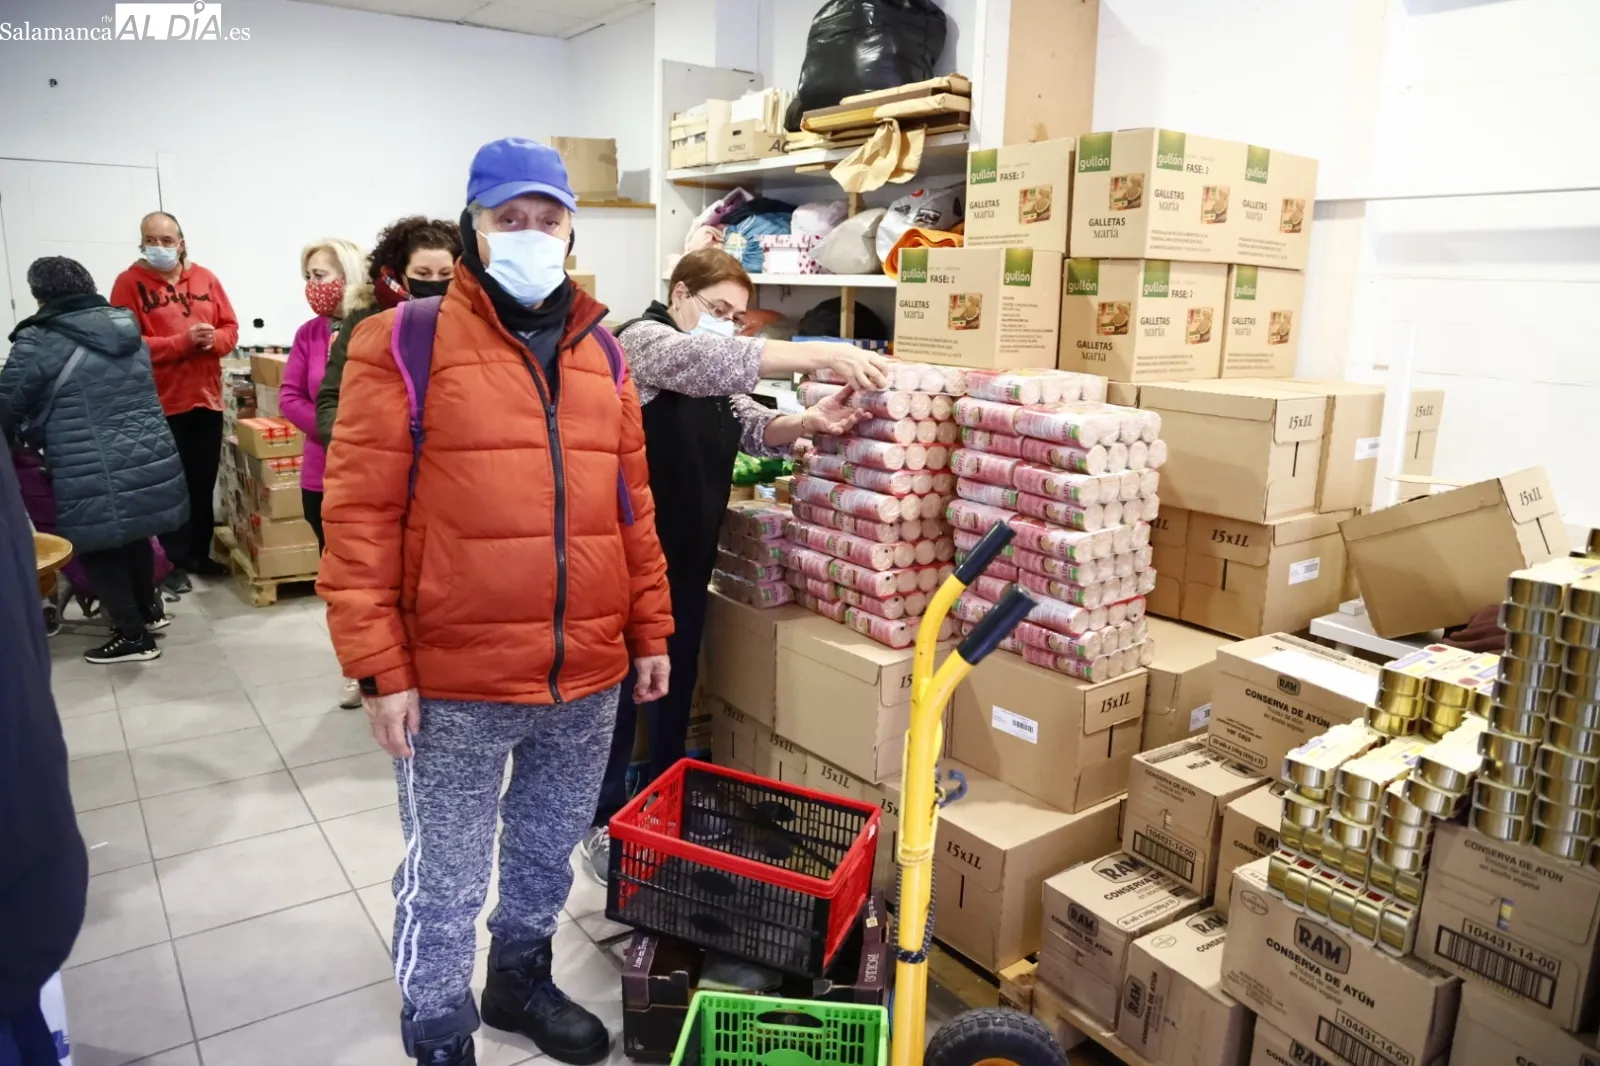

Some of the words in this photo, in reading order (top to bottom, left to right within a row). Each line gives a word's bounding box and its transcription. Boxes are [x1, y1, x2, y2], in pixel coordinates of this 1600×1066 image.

[1080, 154, 1110, 171] gullón
[1158, 152, 1183, 166] gullón
[971, 168, 996, 183] gullón
[1154, 188, 1185, 200] GALLETAS
[969, 199, 1000, 209] GALLETAS
[1088, 217, 1126, 227] GALLETAS
[902, 268, 927, 281] gullón
[930, 274, 950, 284] FASE:
[1005, 270, 1031, 283] gullón
[1068, 278, 1097, 293] gullón
[1143, 280, 1168, 295] gullón
[899, 299, 930, 309] GALLETAS
[1140, 317, 1171, 326] GALLETAS
[1076, 340, 1113, 351] GALLETAS
[1287, 414, 1313, 430] 15x1L
[1519, 486, 1543, 507] 15x1L
[1210, 528, 1249, 548] 15x1L
[1279, 677, 1298, 692] RAM
[1100, 691, 1131, 714] 15x1L
[1245, 687, 1290, 714] CONSERVA
[1291, 707, 1304, 718] DE
[1305, 713, 1331, 729] ATÚN
[769, 732, 795, 754] 15x1L
[821, 765, 850, 790] 15x1L
[880, 798, 899, 818] 15x
[946, 840, 982, 870] 15x1L
[1464, 839, 1517, 865] CONSERVA
[1518, 855, 1533, 869] DE
[1535, 860, 1564, 883] ATÚN
[1100, 855, 1146, 880] RAM
[1103, 877, 1151, 901] CONSERVA
[1191, 914, 1229, 935] RAM
[1196, 935, 1226, 953] CONSER
[1298, 924, 1343, 966] RAM
[1467, 923, 1556, 973] 104431-14-00
[1265, 937, 1322, 977] CONSERVA
[1324, 971, 1342, 987] DE
[1343, 983, 1376, 1010] ATÚN
[1339, 1014, 1410, 1066] 104431-14-00
